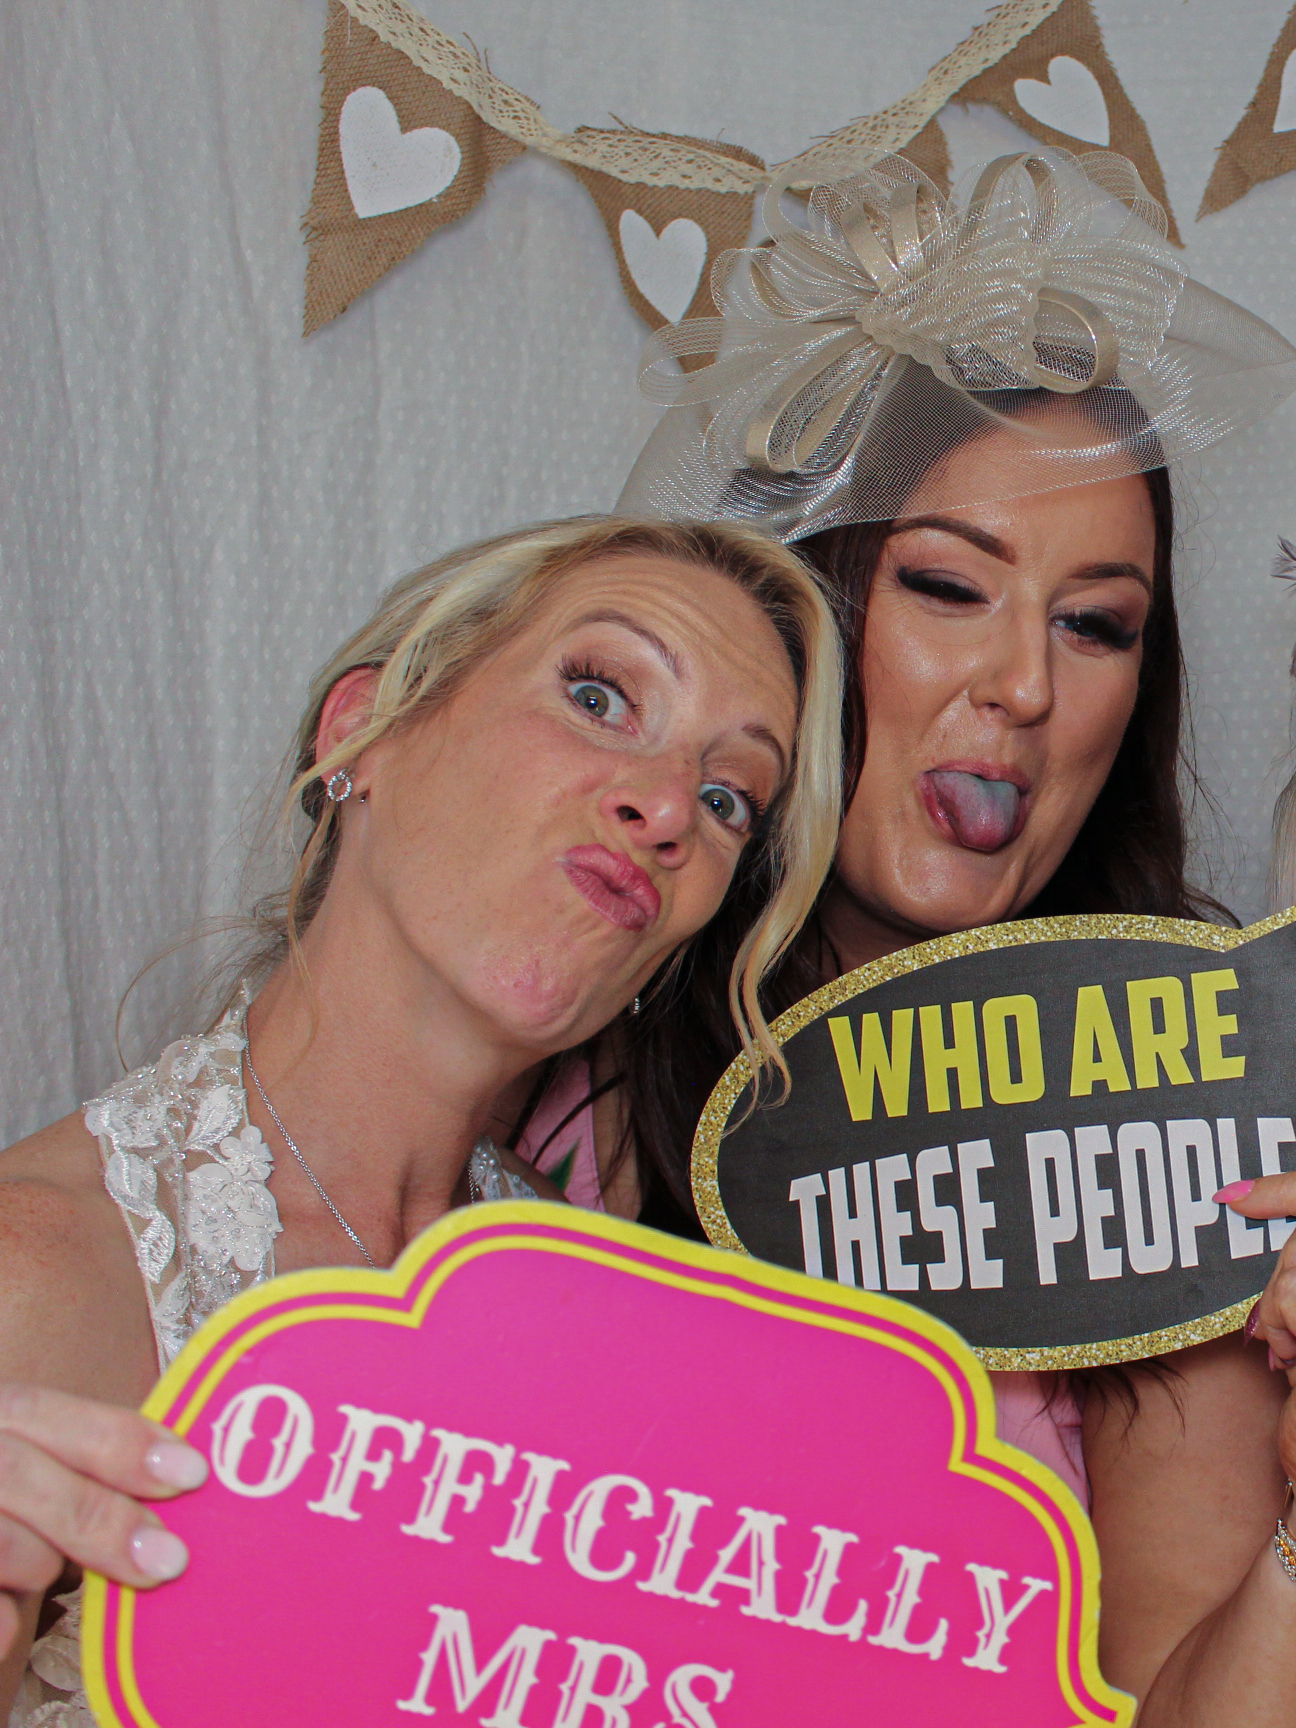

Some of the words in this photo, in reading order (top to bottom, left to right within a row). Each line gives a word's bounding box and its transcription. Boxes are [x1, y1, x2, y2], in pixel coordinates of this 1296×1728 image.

[827, 994, 1046, 1122] WHO
[1070, 967, 1246, 1097] ARE
[788, 1138, 1005, 1291] THESE
[210, 1383, 1054, 1675] OFFICIALLY
[395, 1603, 735, 1728] MRS
